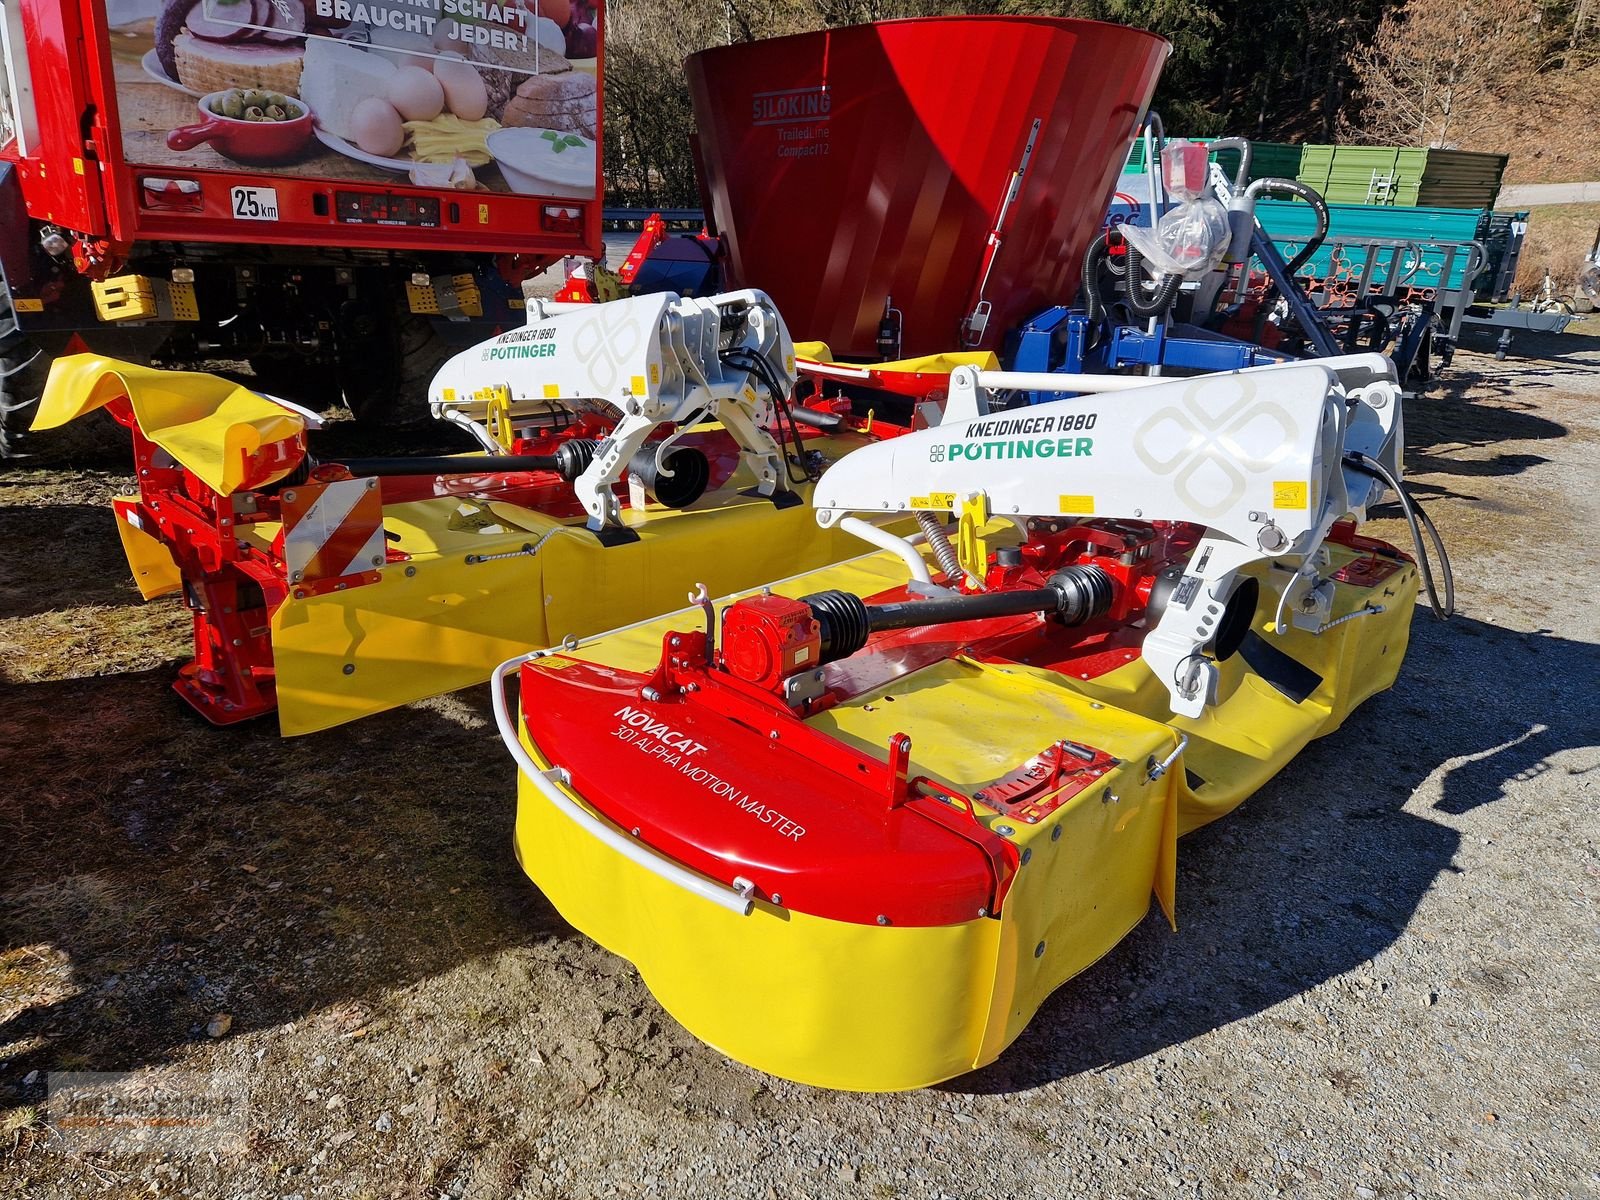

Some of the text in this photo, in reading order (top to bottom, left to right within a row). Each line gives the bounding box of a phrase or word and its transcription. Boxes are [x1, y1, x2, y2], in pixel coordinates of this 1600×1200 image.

[316, 0, 528, 52] BRAUCHT JEDER!
[753, 94, 831, 118] SILOKING
[777, 127, 830, 141] TrailedLine
[1034, 121, 1039, 130] 4
[1026, 145, 1032, 153] 3
[1019, 168, 1024, 176] 2
[235, 190, 277, 217] 25 km
[497, 328, 556, 344] KNEIDINGER 1880
[965, 413, 1097, 438] KNEIDINGER 1880
[613, 706, 708, 756] NOVACAT
[610, 725, 806, 842] 301 ALPHA MOTION MASTER
